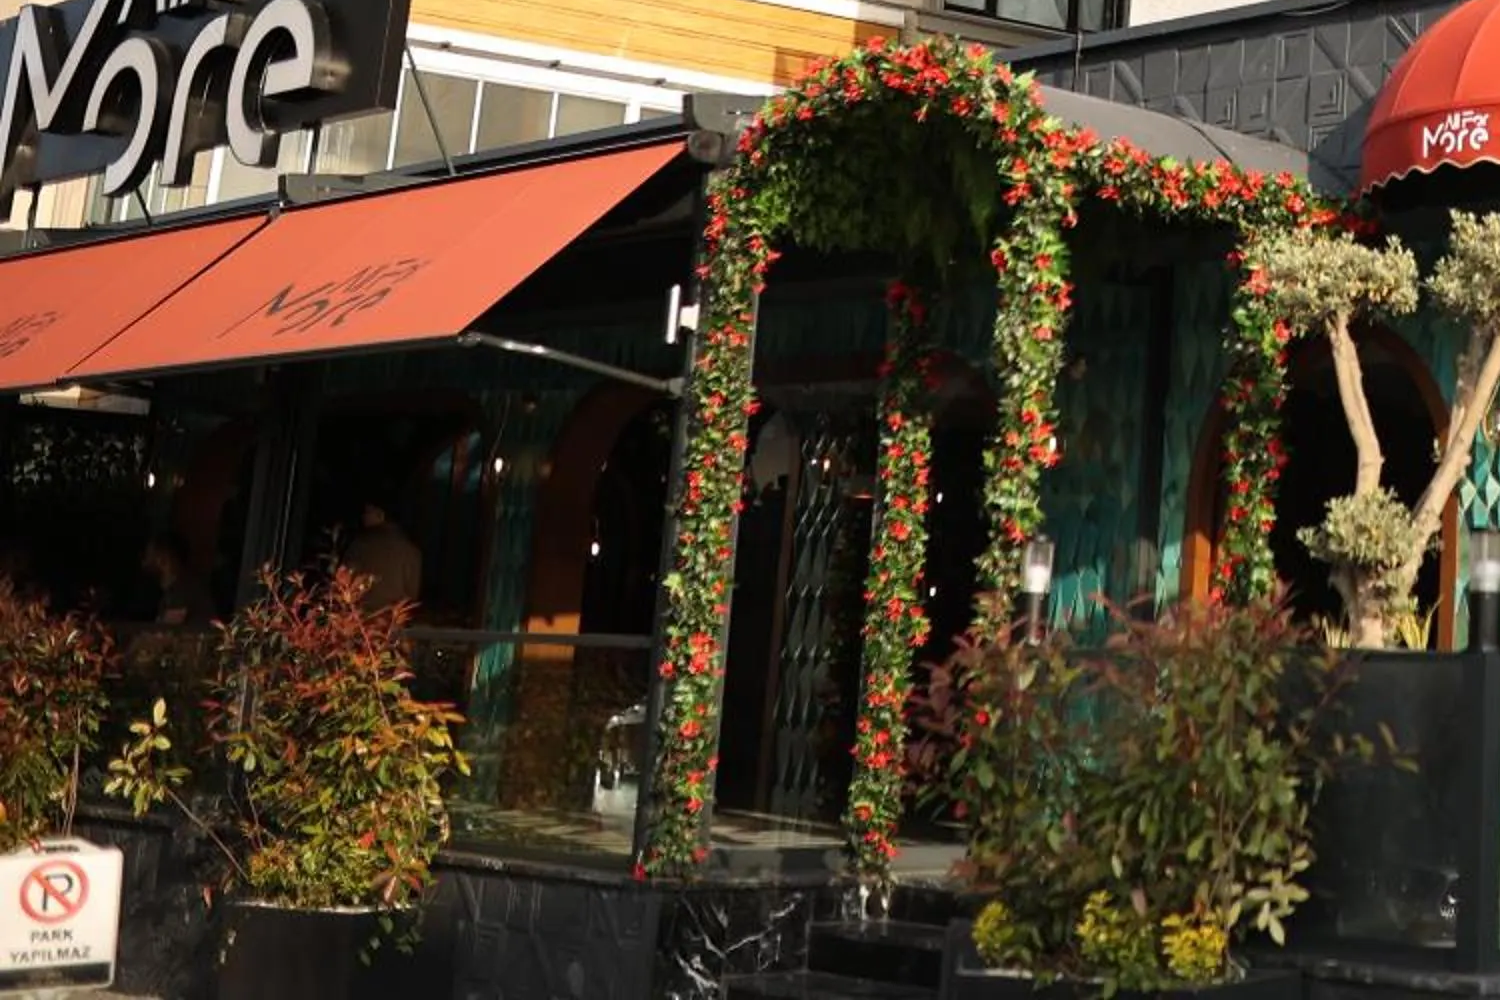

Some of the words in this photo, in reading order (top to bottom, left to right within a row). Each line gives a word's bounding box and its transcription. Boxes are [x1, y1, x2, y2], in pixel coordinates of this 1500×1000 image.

[1422, 122, 1490, 159] More
[30, 928, 74, 944] PARK
[9, 946, 92, 964] YAPILMAZ
